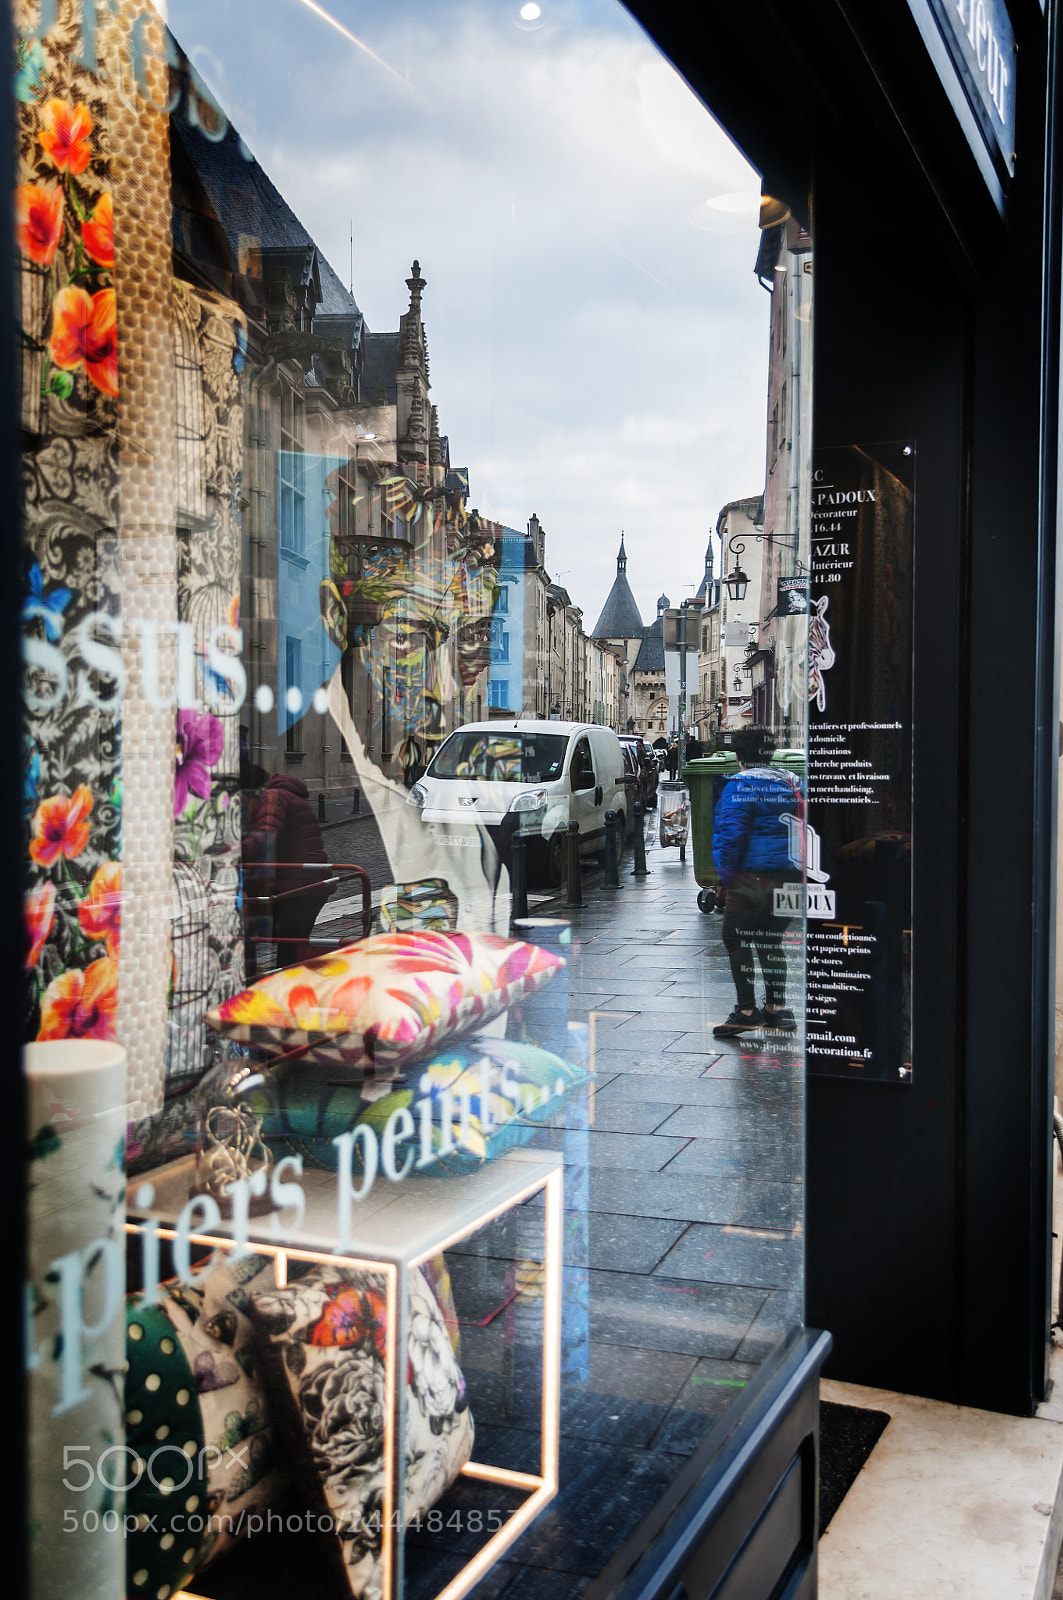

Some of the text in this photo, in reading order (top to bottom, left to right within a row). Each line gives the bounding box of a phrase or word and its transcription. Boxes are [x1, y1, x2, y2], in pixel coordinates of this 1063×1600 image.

[957, 0, 1008, 125] ieur
[817, 489, 877, 506] PADOUX
[813, 542, 850, 557] AZUR
[847, 721, 903, 732] professionnels
[813, 734, 846, 742] domicile
[809, 747, 852, 755] réalisations
[840, 760, 872, 770] produits
[857, 771, 890, 780] livraison
[820, 944, 847, 954] papiers
[847, 945, 871, 955] peints
[811, 956, 820, 964] de
[821, 957, 843, 965] stores
[830, 969, 871, 979] luminaires
[819, 1008, 837, 1016] pose
